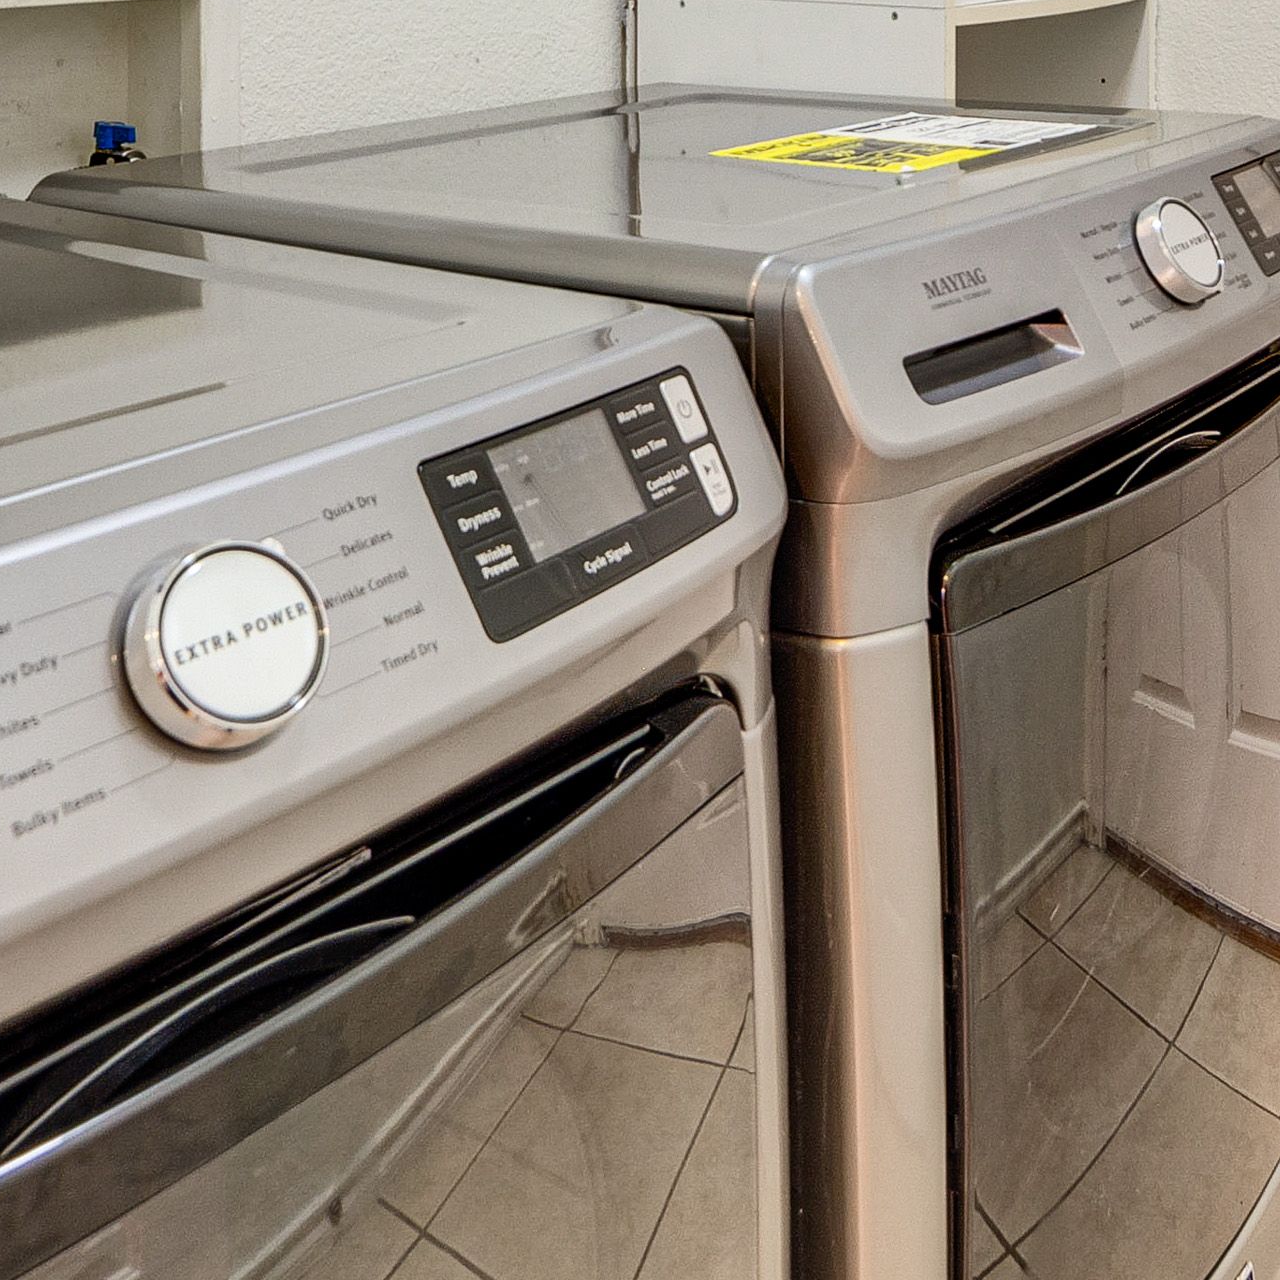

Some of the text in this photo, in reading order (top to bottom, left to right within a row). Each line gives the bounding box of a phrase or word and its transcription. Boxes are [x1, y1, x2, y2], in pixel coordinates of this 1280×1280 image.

[921, 267, 987, 299] MAYTAG
[635, 402, 655, 416] Time
[631, 438, 668, 460] Less Time
[446, 470, 478, 489] Temp
[646, 464, 690, 492] Control Lock
[322, 493, 378, 521] Quick Dry
[457, 507, 502, 533] Dryness
[340, 529, 393, 558] Delicates
[475, 544, 513, 567] Wrinkle
[481, 555, 520, 580] Prevent
[583, 541, 633, 575] Cycle Signal
[323, 566, 409, 611] Wrinkle Control
[383, 600, 425, 626] Normal
[174, 601, 308, 666] EXTRA POWER
[20, 655, 58, 678] Duty
[380, 638, 439, 672] Timed Dry
[10, 787, 108, 838] Bulky Items
